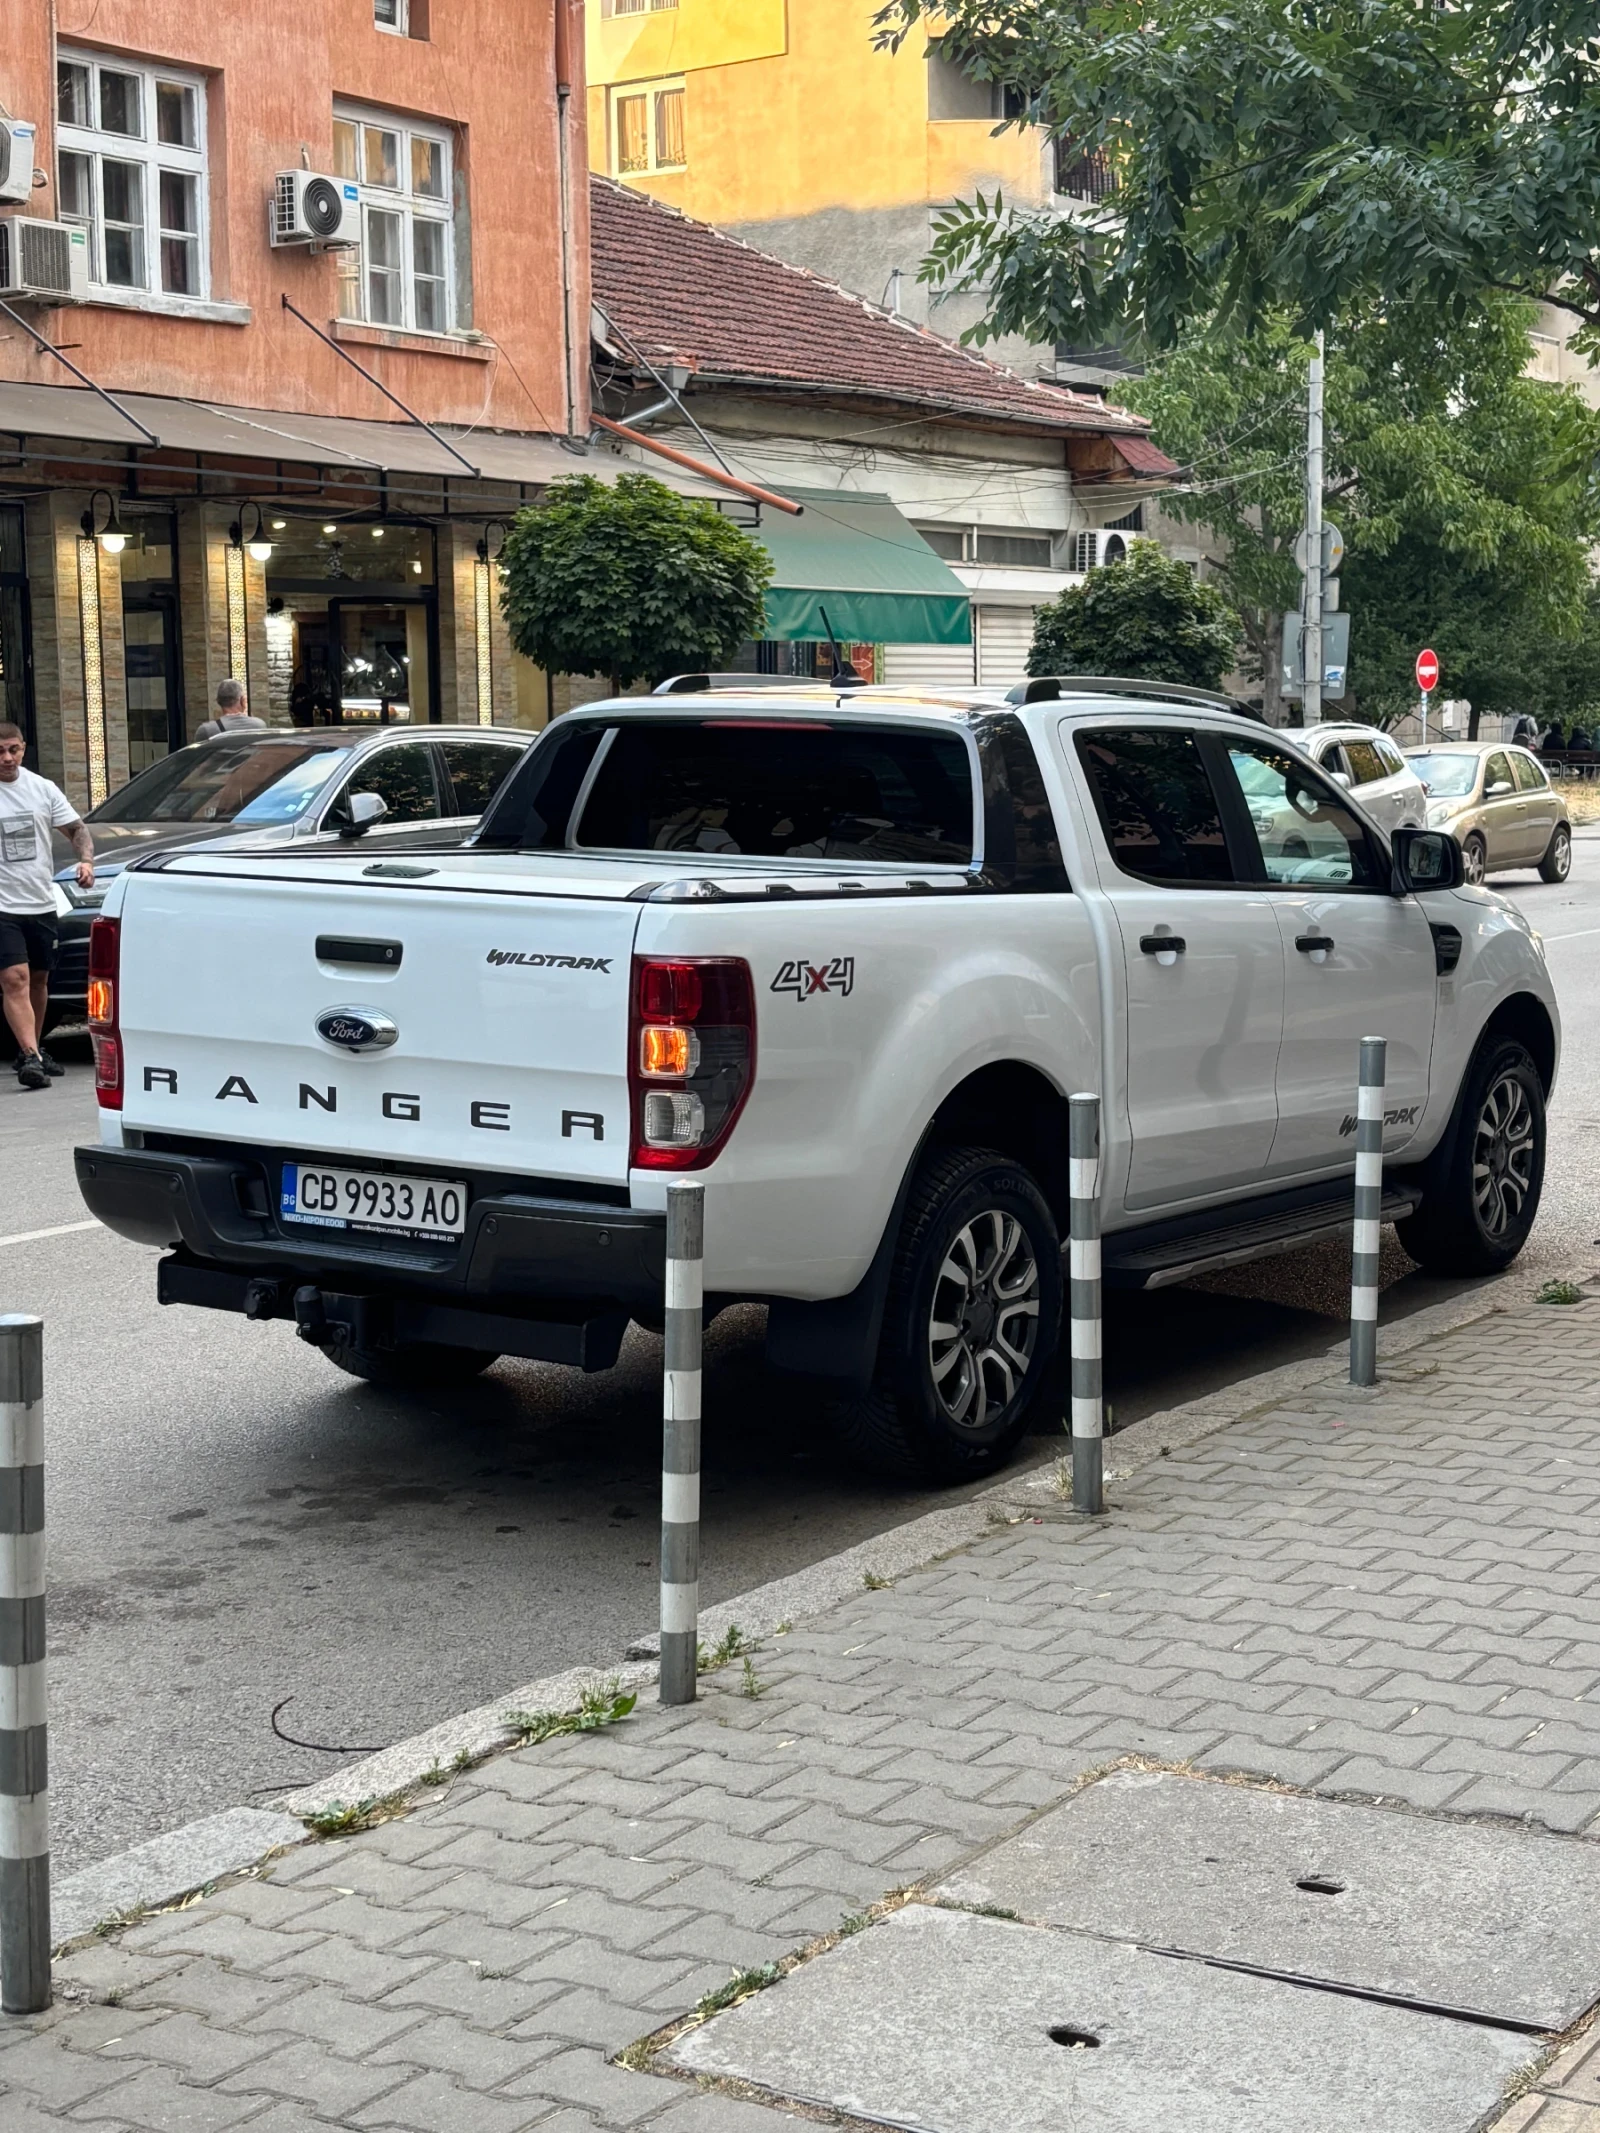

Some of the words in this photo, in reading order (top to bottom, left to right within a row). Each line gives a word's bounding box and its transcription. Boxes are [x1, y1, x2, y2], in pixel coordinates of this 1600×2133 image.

[486, 949, 614, 974] WILDTRAK
[329, 1018, 365, 1040] Ford
[143, 1066, 604, 1141] RANGER
[1339, 1106, 1419, 1137] WIRAK
[282, 1193, 296, 1206] BG
[301, 1173, 338, 1211] CB
[345, 1178, 414, 1221] 9933
[421, 1187, 460, 1226] AO
